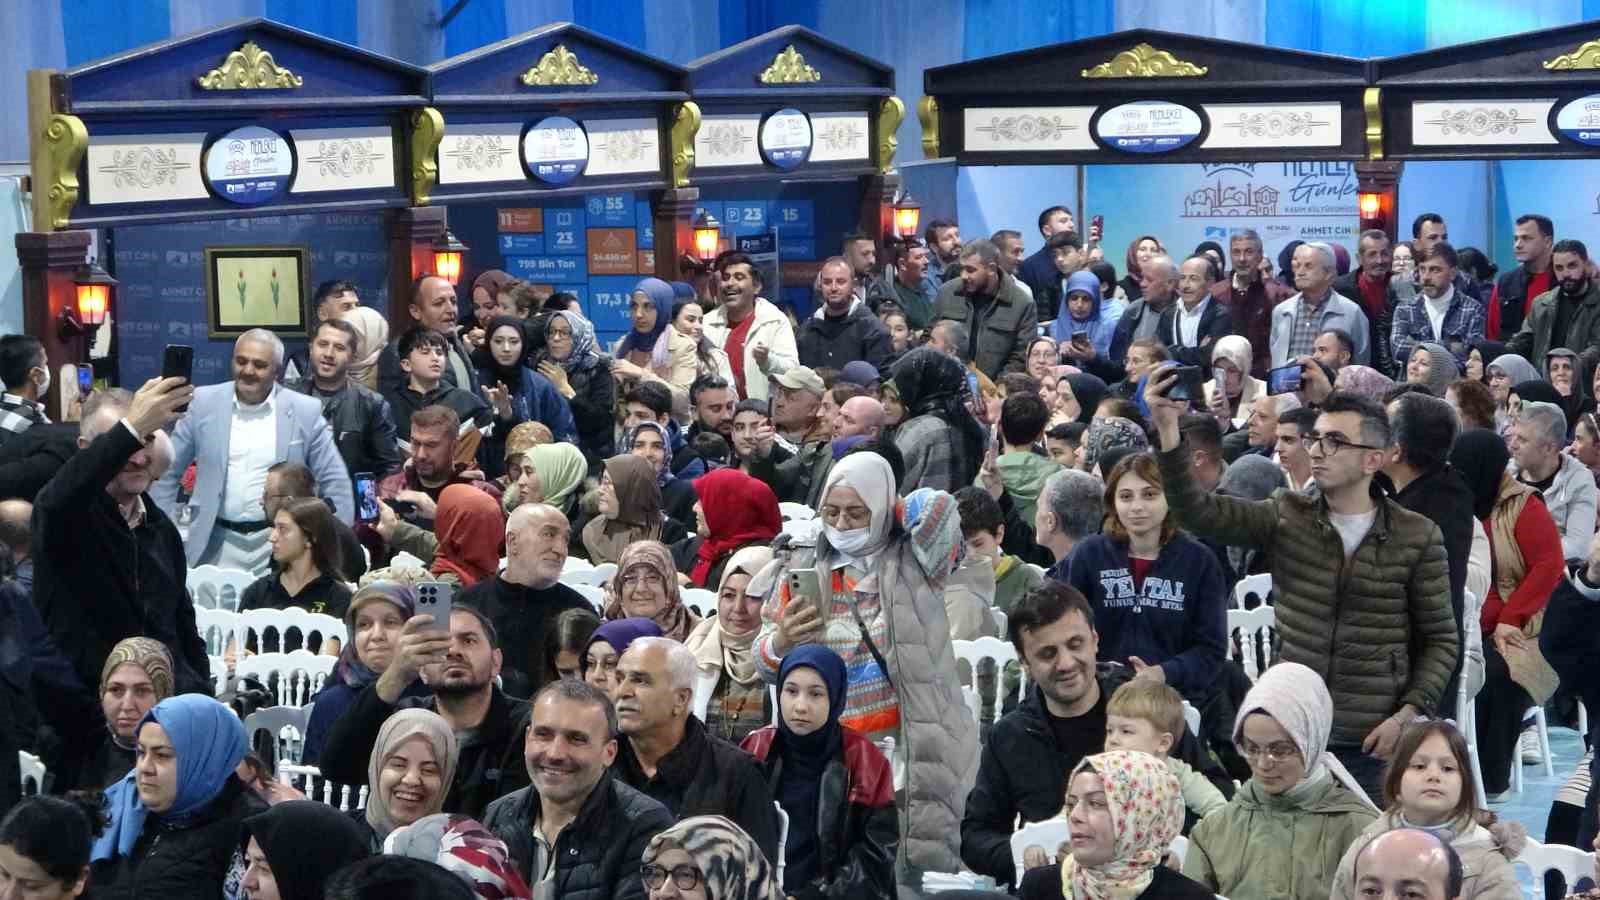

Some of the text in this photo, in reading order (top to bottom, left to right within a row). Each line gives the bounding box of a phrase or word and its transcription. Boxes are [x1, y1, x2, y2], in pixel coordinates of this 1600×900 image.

[606, 196, 624, 209] 55
[743, 207, 763, 221] 23
[781, 207, 799, 221] 15
[1300, 226, 1332, 235] AHMET
[503, 235, 513, 249] 3
[555, 231, 575, 245] 23
